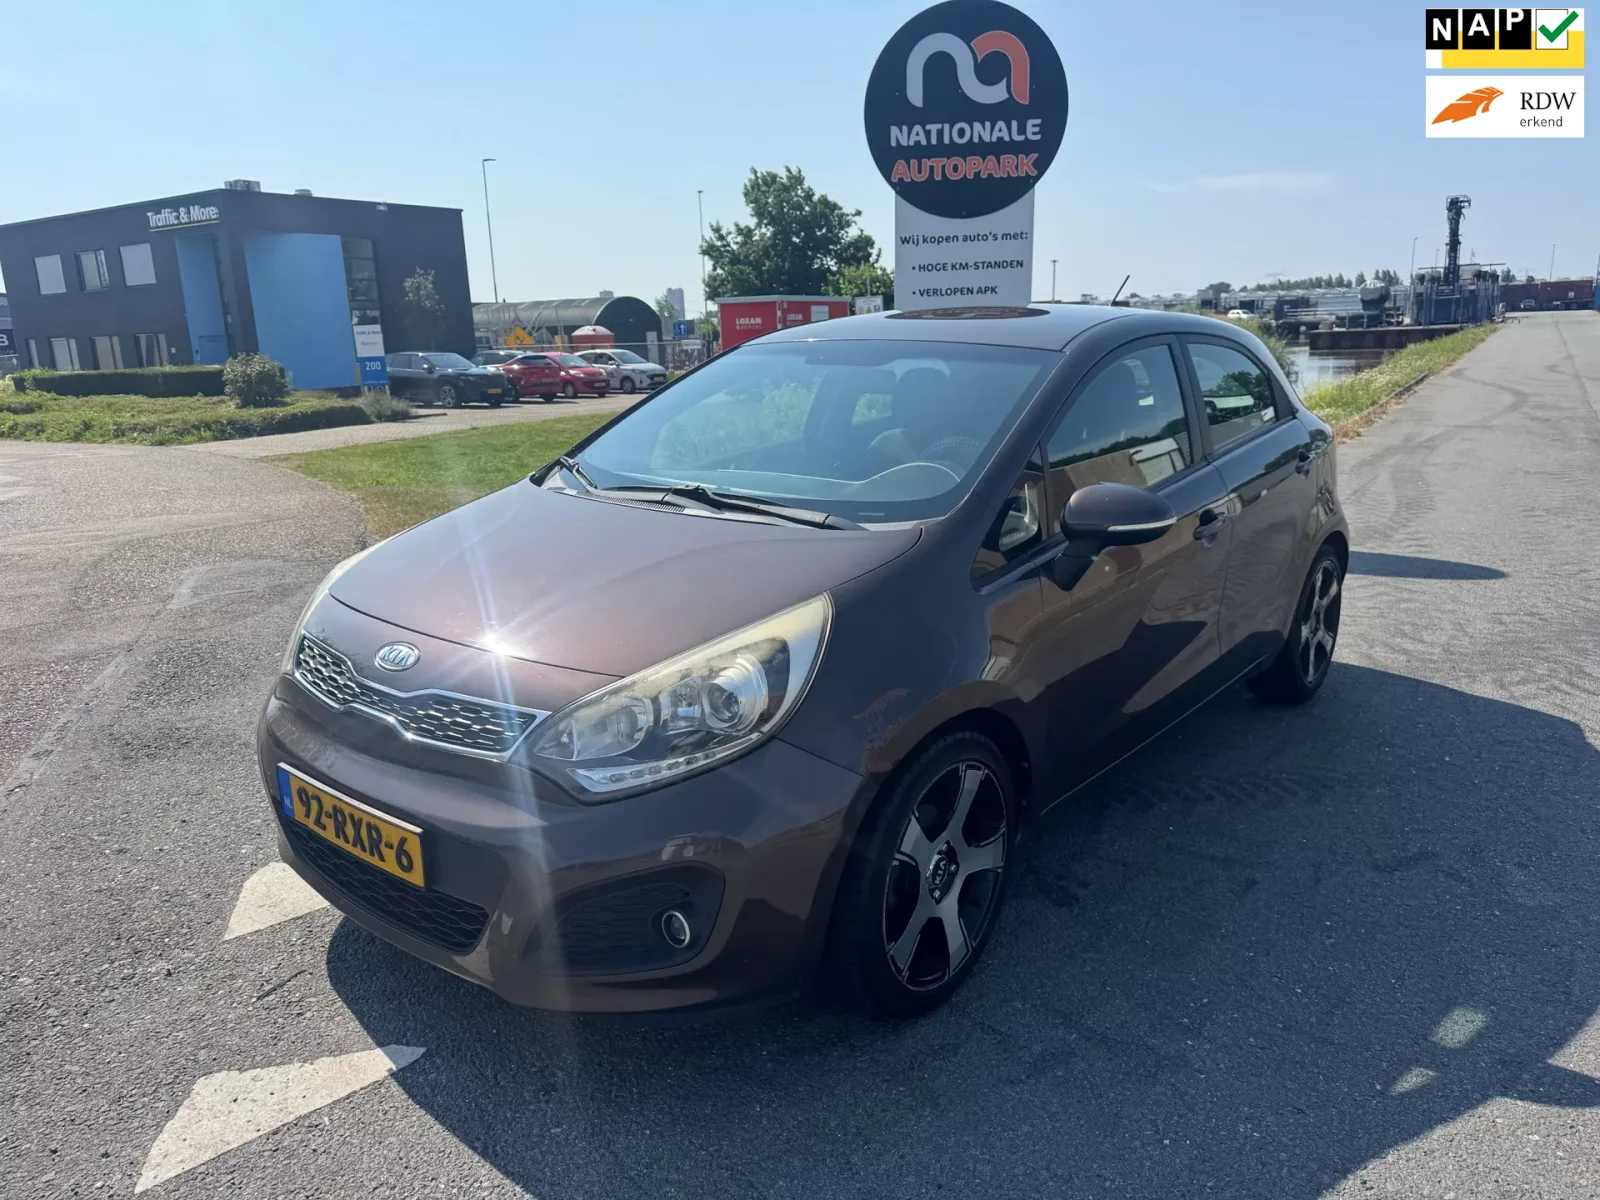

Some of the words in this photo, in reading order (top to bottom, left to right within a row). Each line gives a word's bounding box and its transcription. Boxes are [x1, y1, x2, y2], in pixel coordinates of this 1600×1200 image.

[890, 118, 1042, 148] NATIONALE
[891, 153, 1039, 183] AUTOPARK
[146, 208, 179, 228] Traffic
[179, 207, 190, 223] &
[189, 204, 220, 222] More
[899, 234, 920, 247] Wij
[922, 233, 960, 246] kopen
[961, 231, 999, 243] auto's
[1001, 230, 1029, 241] met:
[918, 262, 949, 273] HOGE
[951, 259, 1024, 272] KM-STANDEN
[918, 286, 974, 298] VERLOPEN
[976, 285, 999, 296] APK
[735, 317, 762, 325] LOXAM
[365, 361, 382, 371] 200
[380, 645, 411, 668] KIA
[283, 795, 293, 809] NL
[296, 785, 414, 874] 92-RXR-6
[933, 859, 947, 885] KIA
